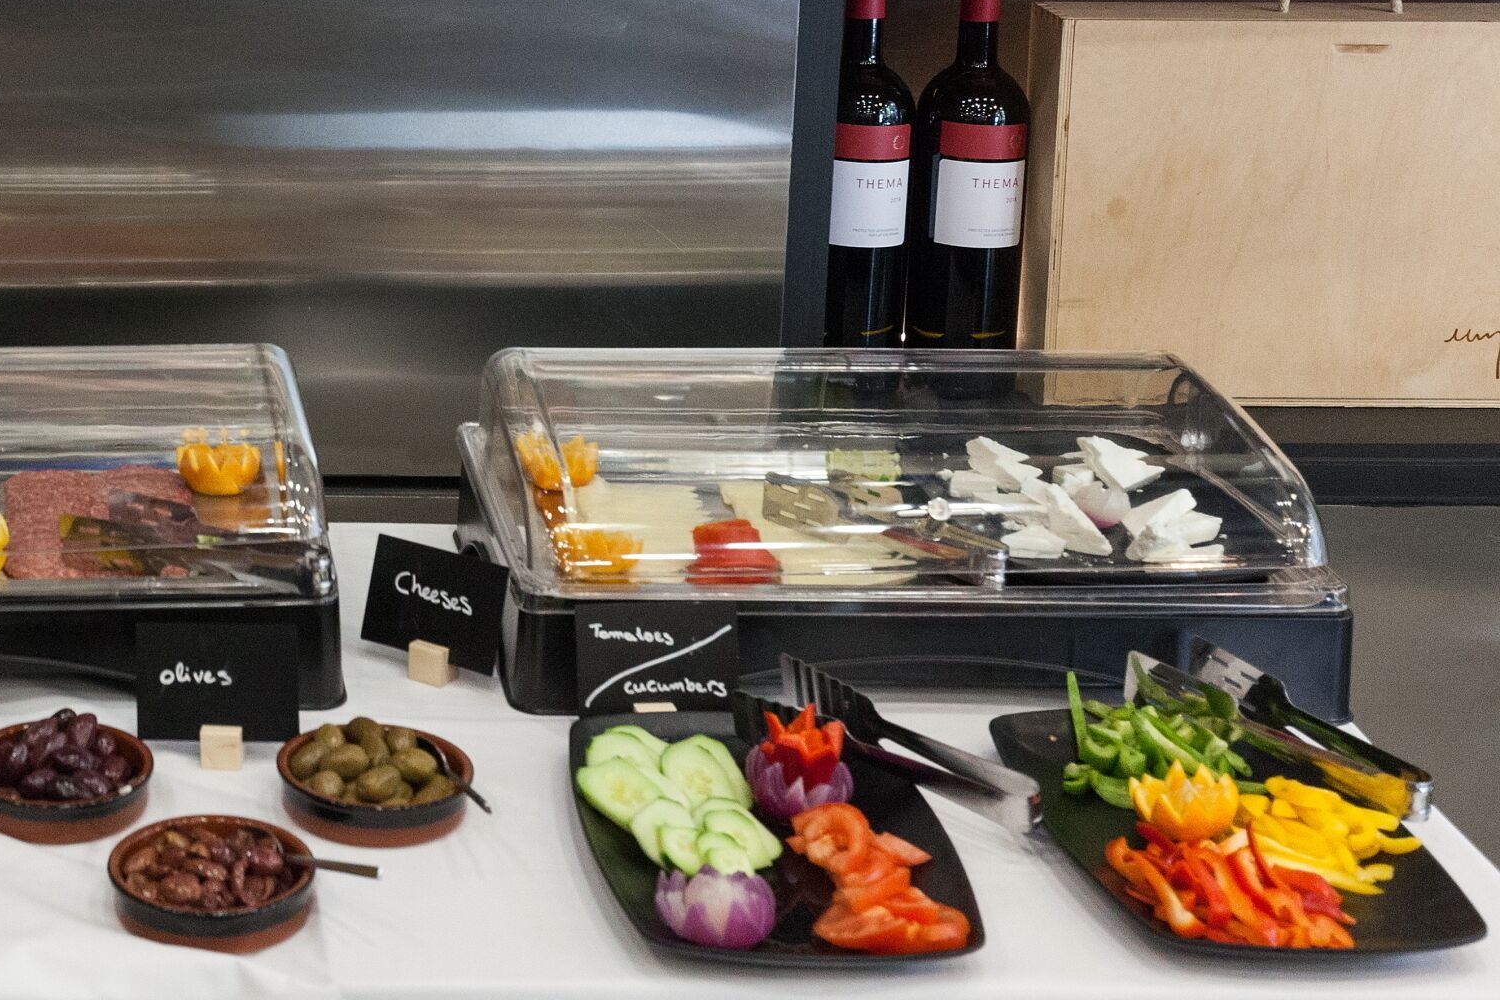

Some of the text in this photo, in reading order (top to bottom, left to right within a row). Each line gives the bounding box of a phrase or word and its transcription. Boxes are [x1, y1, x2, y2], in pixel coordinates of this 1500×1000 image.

[856, 178, 903, 189] THEMA
[972, 178, 1019, 189] THEMA
[395, 571, 472, 616] Cheeses
[588, 623, 674, 646] Tomatoes
[159, 661, 232, 686] olives
[623, 677, 728, 698] cucumbers
